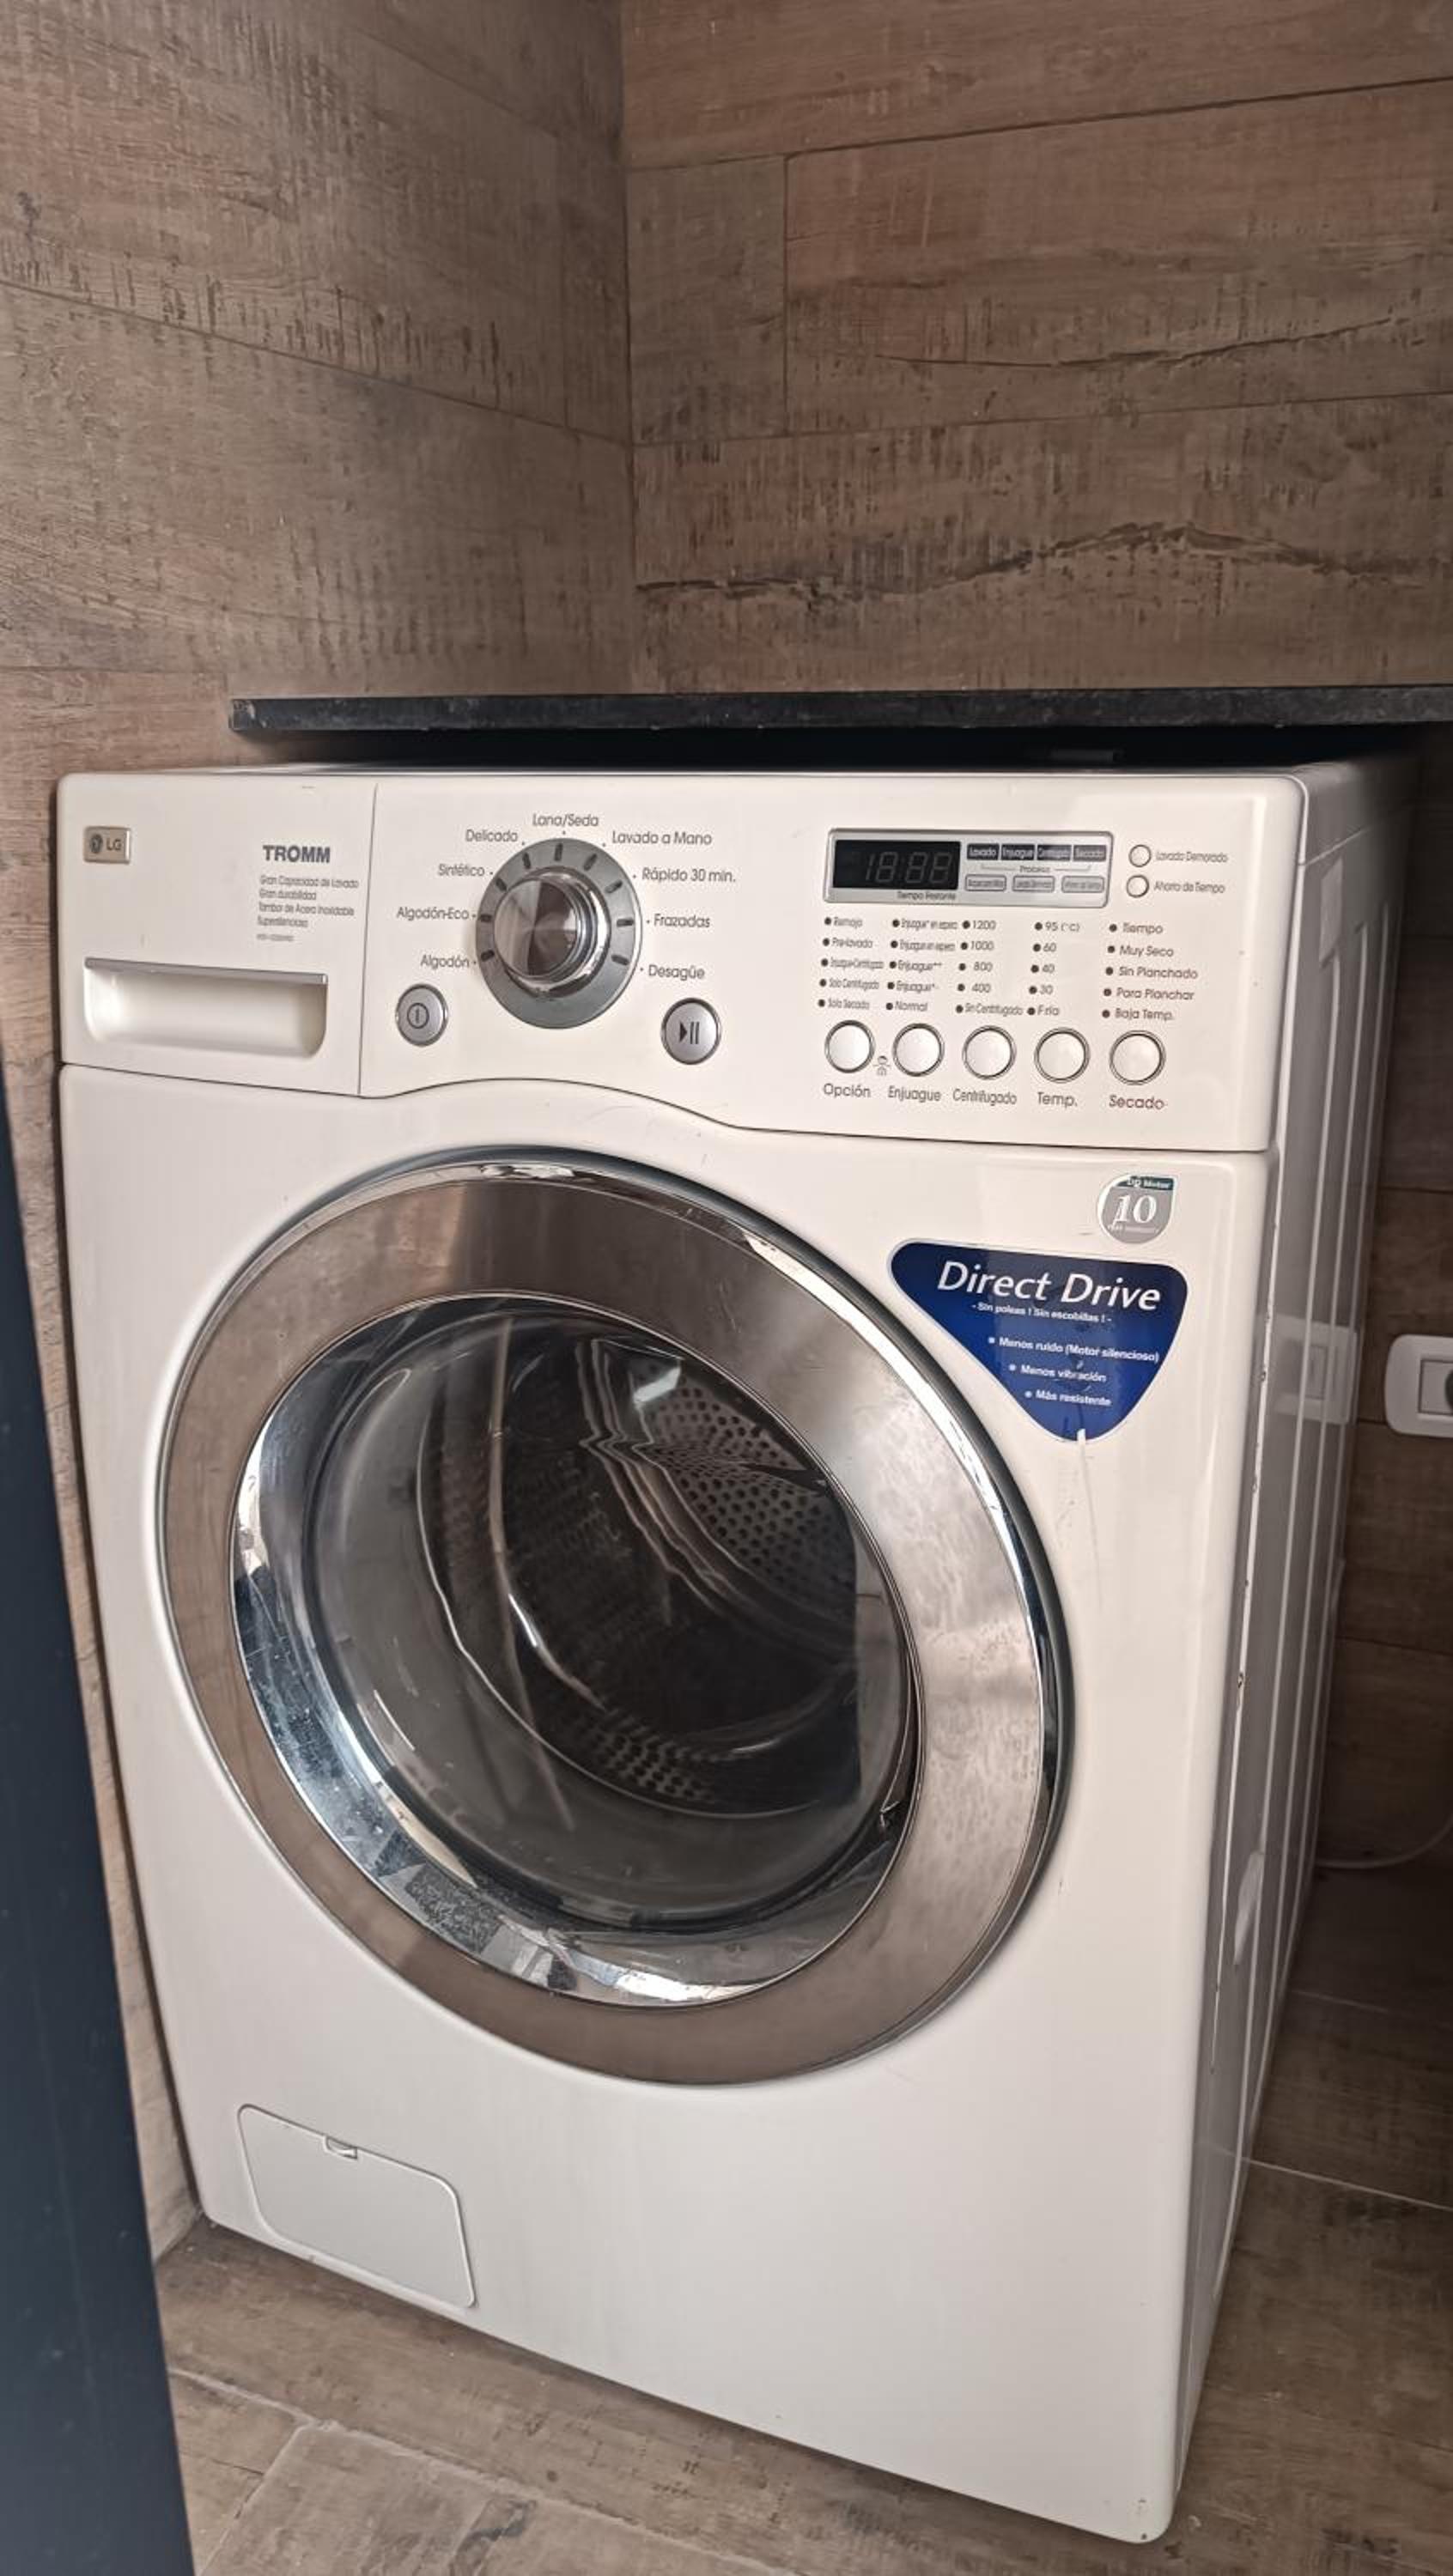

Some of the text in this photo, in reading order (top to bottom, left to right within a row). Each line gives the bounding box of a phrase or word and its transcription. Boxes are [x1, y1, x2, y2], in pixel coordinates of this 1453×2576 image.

[465, 829, 518, 842] Delicado
[612, 831, 712, 846] Lavado a Mano
[106, 837, 123, 852] LG
[262, 845, 331, 864] TROMM
[438, 863, 485, 878] Sintético
[641, 867, 736, 884] Rápido 30 min.
[396, 906, 470, 920] Algodón-Eco
[654, 914, 711, 929] Frazadas
[972, 920, 996, 931] 1200
[1045, 921, 1058, 932] 95
[970, 940, 994, 951] 1000
[1043, 942, 1057, 952] 60
[1119, 945, 1174, 958] Muy Seco
[421, 954, 470, 969] Algodón
[973, 961, 994, 972] 800
[1042, 963, 1055, 974] 40
[648, 963, 705, 981] Desagüe
[1119, 966, 1198, 980] Sin Planchado
[971, 983, 992, 993] 400
[1039, 984, 1054, 995] 30
[1116, 987, 1195, 1000] Para Planchar
[895, 1000, 928, 1012] Normal
[1115, 1007, 1140, 1021] Baja
[823, 1083, 871, 1099] Opción
[888, 1084, 942, 1103] Enjuague
[952, 1088, 1018, 1107] Centrifugado
[1037, 1091, 1078, 1110] Temp.
[1109, 1093, 1164, 1110] Secado
[1114, 1194, 1157, 1224] 10
[937, 1261, 1161, 1311] Direct Drive
[977, 1303, 994, 1312] Sin
[995, 1305, 1027, 1318] poleas
[1051, 1309, 1099, 1323] escobillas
[999, 1337, 1159, 1364] Menos ruido (Motor silencioso)
[1020, 1364, 1107, 1383] Menos vibración
[1036, 1388, 1112, 1407] Más resistente
